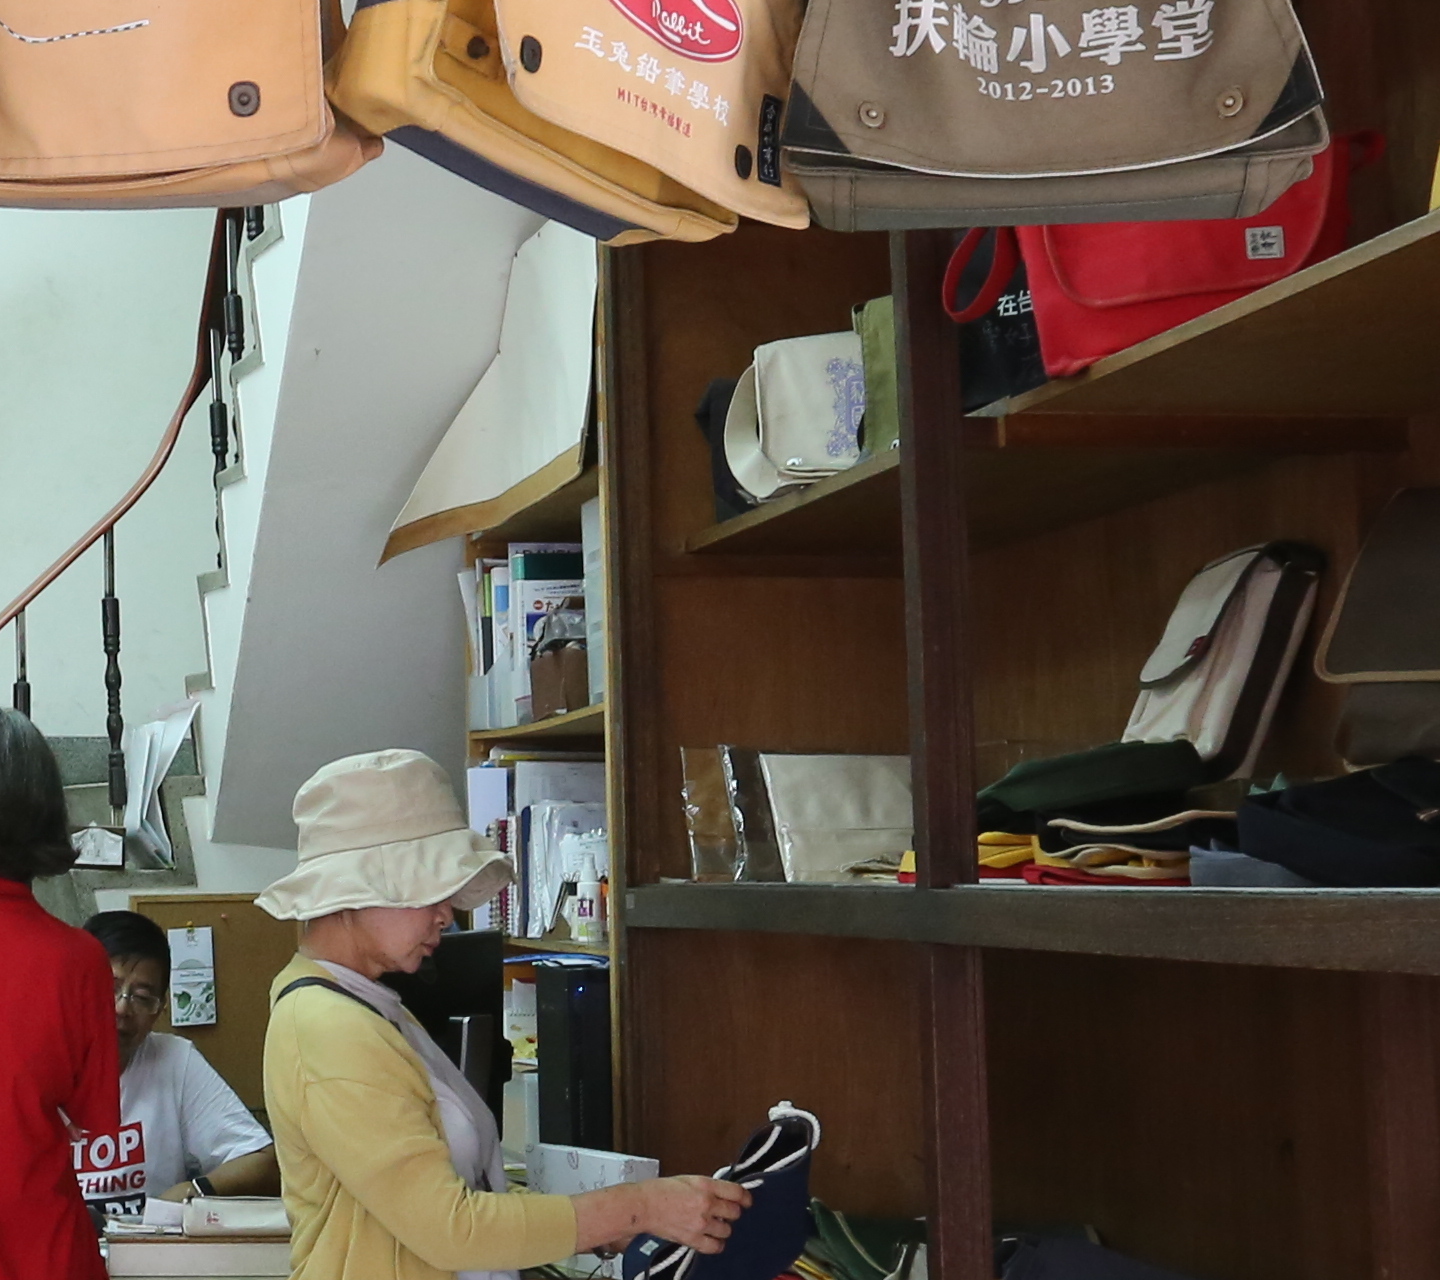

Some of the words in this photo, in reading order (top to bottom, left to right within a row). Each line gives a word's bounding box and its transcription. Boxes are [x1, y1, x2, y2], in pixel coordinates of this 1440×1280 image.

[574, 25, 732, 127] 玉兔鉛筆學校
[976, 73, 1116, 102] 2012-2013
[71, 1128, 141, 1170] TOP
[83, 1169, 147, 1195] HING
